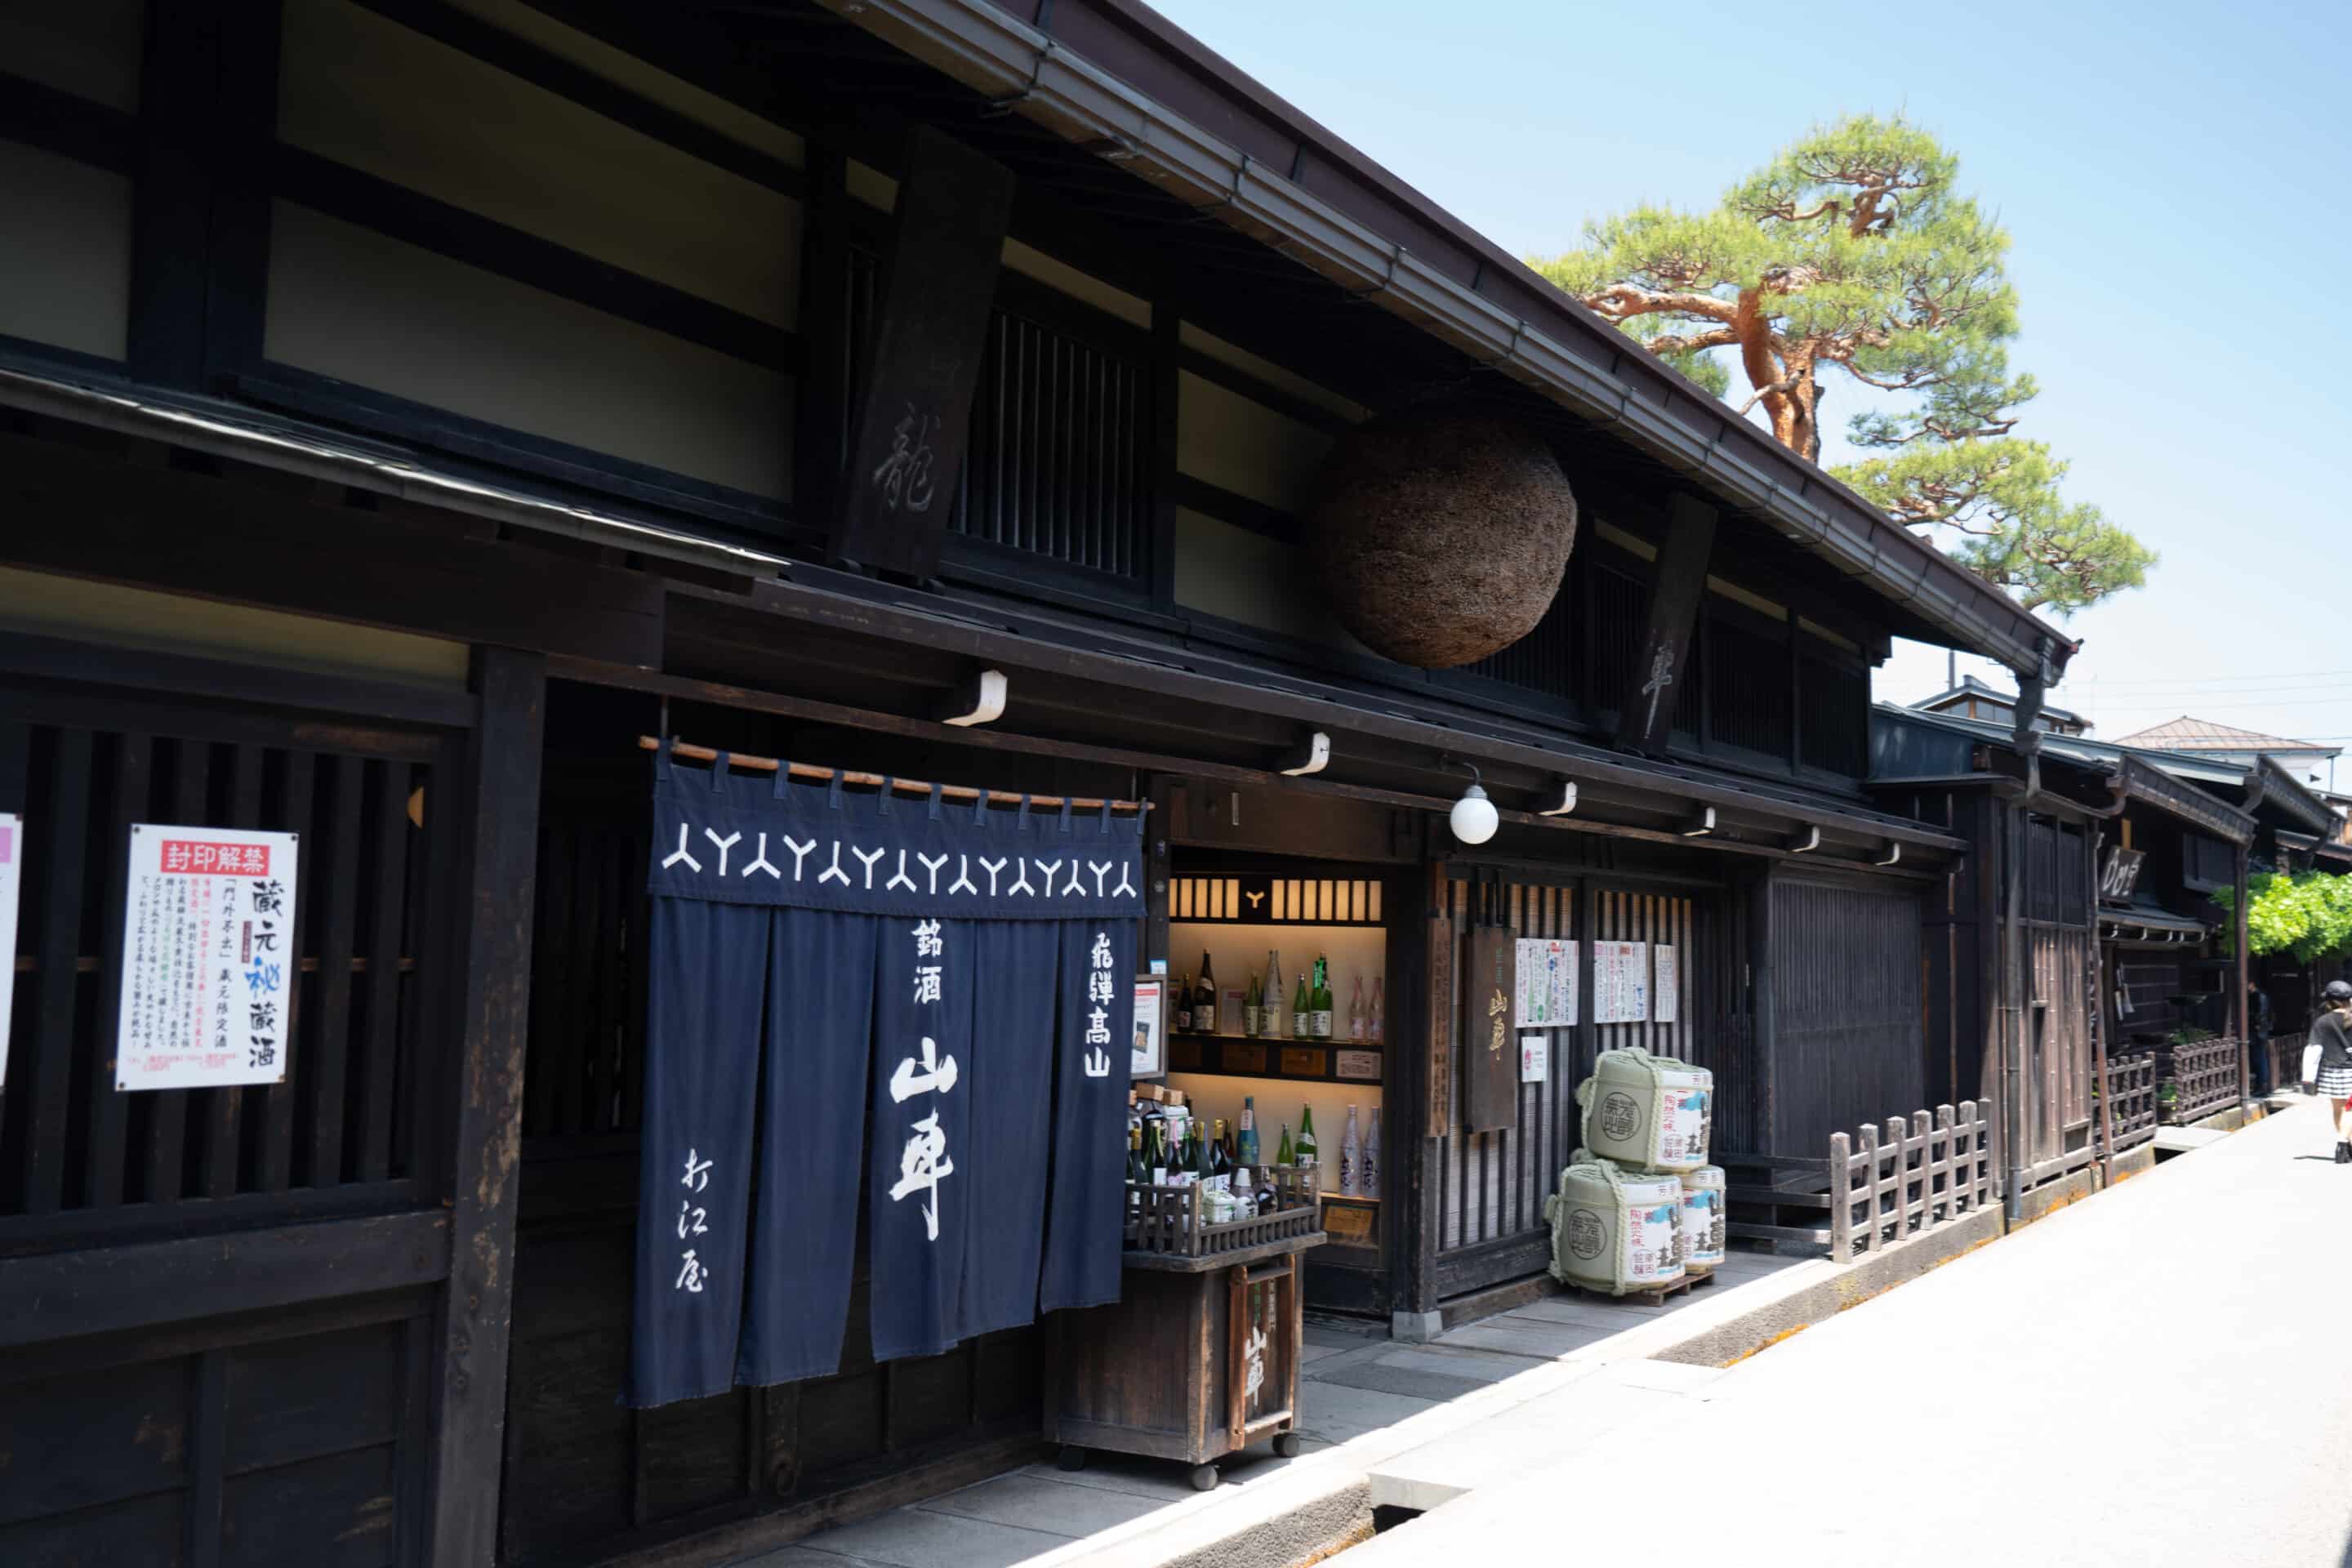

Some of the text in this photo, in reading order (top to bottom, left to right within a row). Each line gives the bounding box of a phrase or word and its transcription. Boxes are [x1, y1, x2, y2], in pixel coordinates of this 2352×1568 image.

[166, 843, 265, 873] 封印解禁
[244, 880, 284, 1068] 蔵元秘蔵酒
[889, 918, 958, 1241] 銘酒 山車
